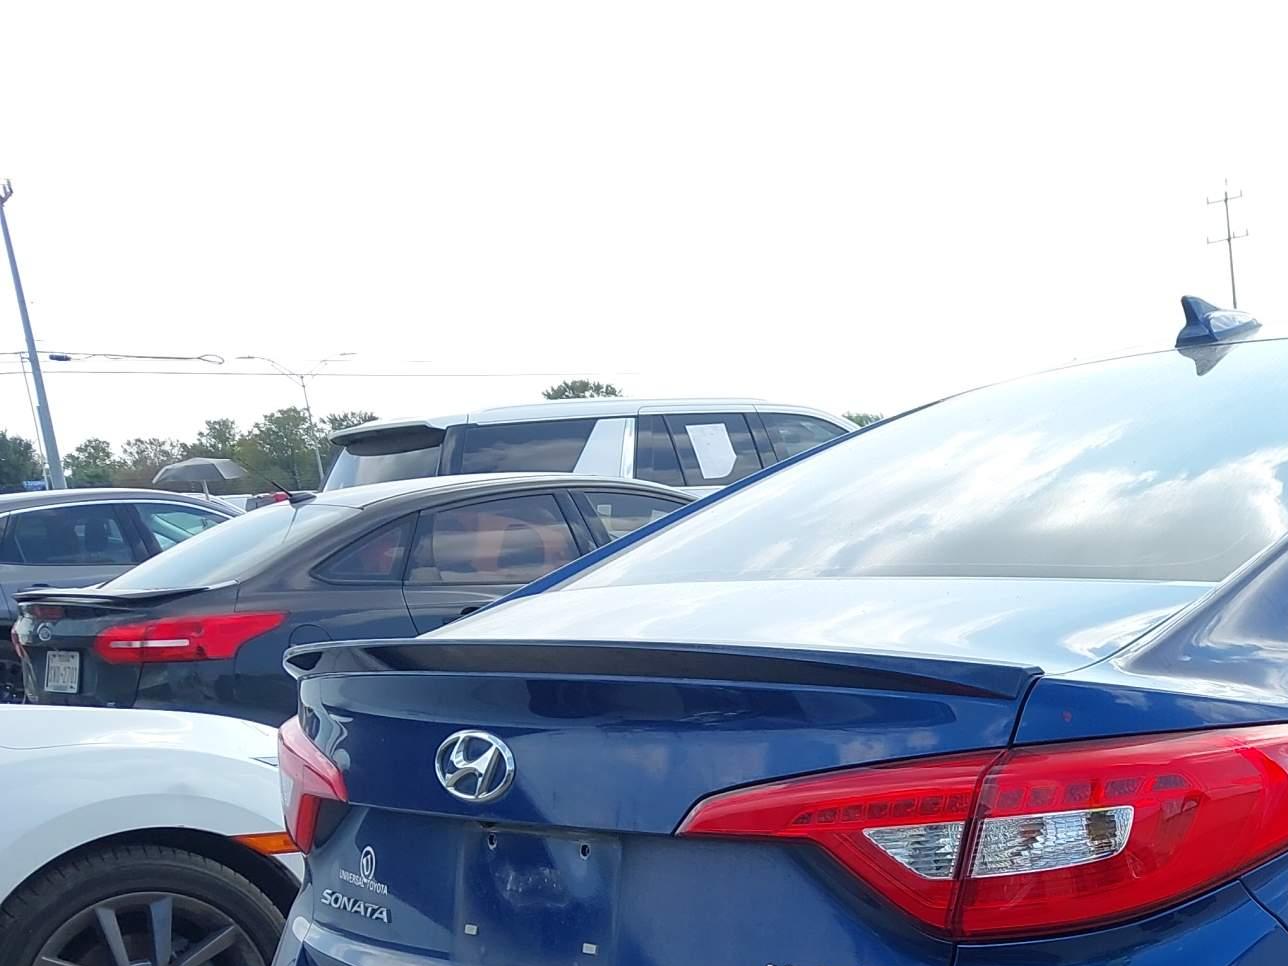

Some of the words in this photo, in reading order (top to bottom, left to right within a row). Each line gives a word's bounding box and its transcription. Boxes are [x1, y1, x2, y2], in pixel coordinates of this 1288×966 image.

[340, 869, 365, 888] UNIVERSAL
[366, 880, 388, 896] TOYOTA
[320, 889, 388, 924] SONATA
